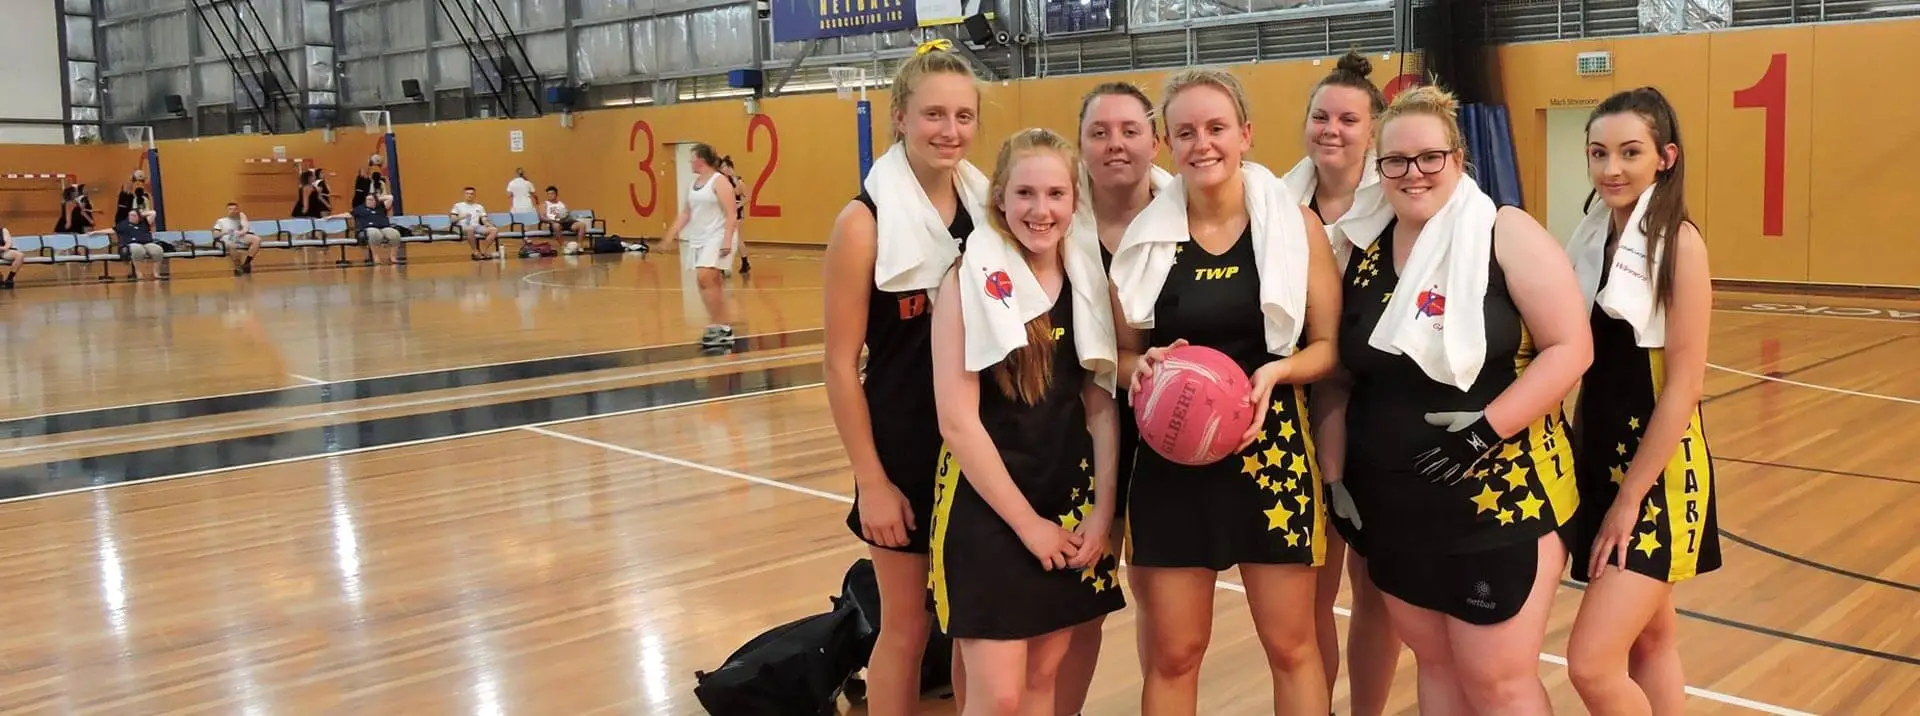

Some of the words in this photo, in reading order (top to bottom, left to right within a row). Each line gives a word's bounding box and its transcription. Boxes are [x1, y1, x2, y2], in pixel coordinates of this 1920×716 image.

[819, 0, 902, 16] NETB
[820, 12, 882, 29] ASSOCIATION
[886, 10, 903, 21] INC
[629, 120, 657, 217] 3
[747, 113, 781, 217] 2
[1733, 53, 1787, 236] 1
[1195, 266, 1239, 281] TWP
[1161, 381, 1197, 454] GILBERT
[1680, 422, 1699, 554] TARZ
